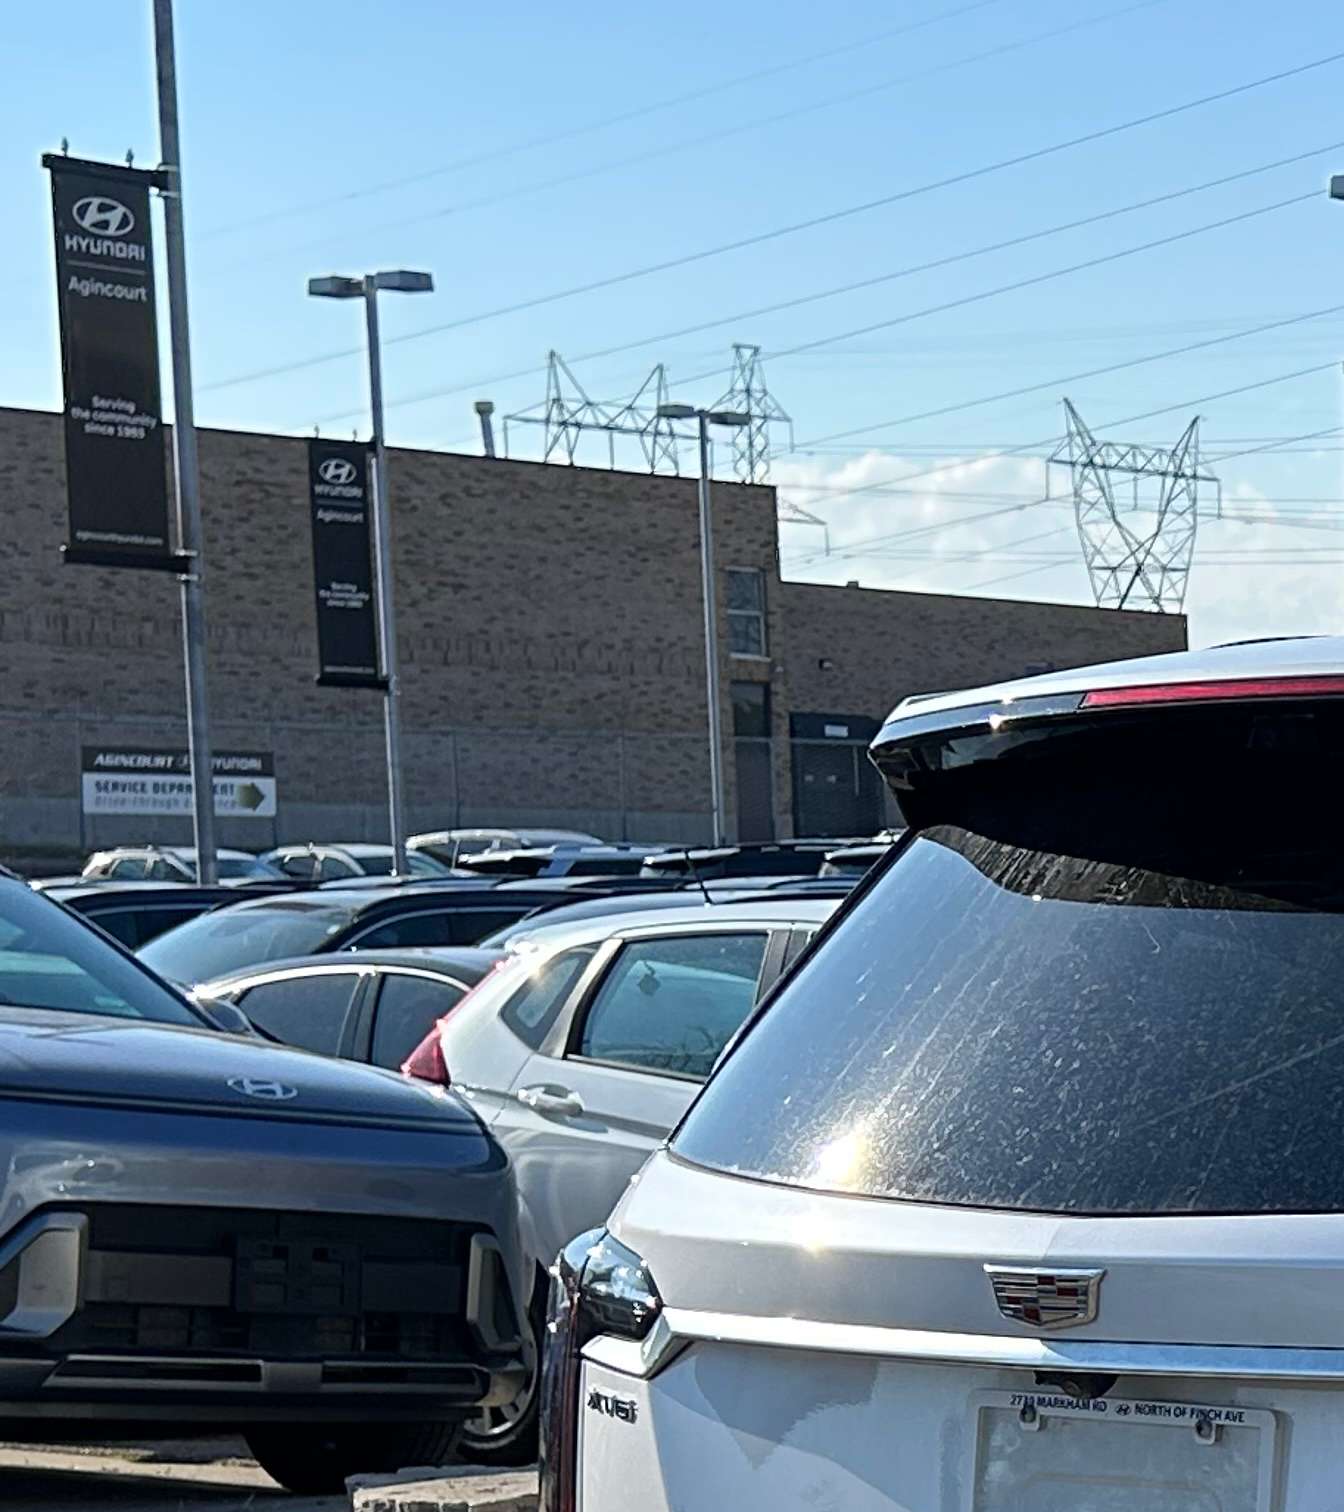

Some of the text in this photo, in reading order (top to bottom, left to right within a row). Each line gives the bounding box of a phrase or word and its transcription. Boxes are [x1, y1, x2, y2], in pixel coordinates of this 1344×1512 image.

[64, 234, 146, 261] HYUNDAI
[68, 276, 148, 302] Agincourt
[94, 753, 174, 769] AGINCOURT
[95, 780, 235, 797] SERVICE DEPARENT
[1093, 1399, 1108, 1412] RD
[1135, 1403, 1171, 1417] NORTH
[1173, 1406, 1187, 1418] OF
[1224, 1410, 1246, 1423] AVE
